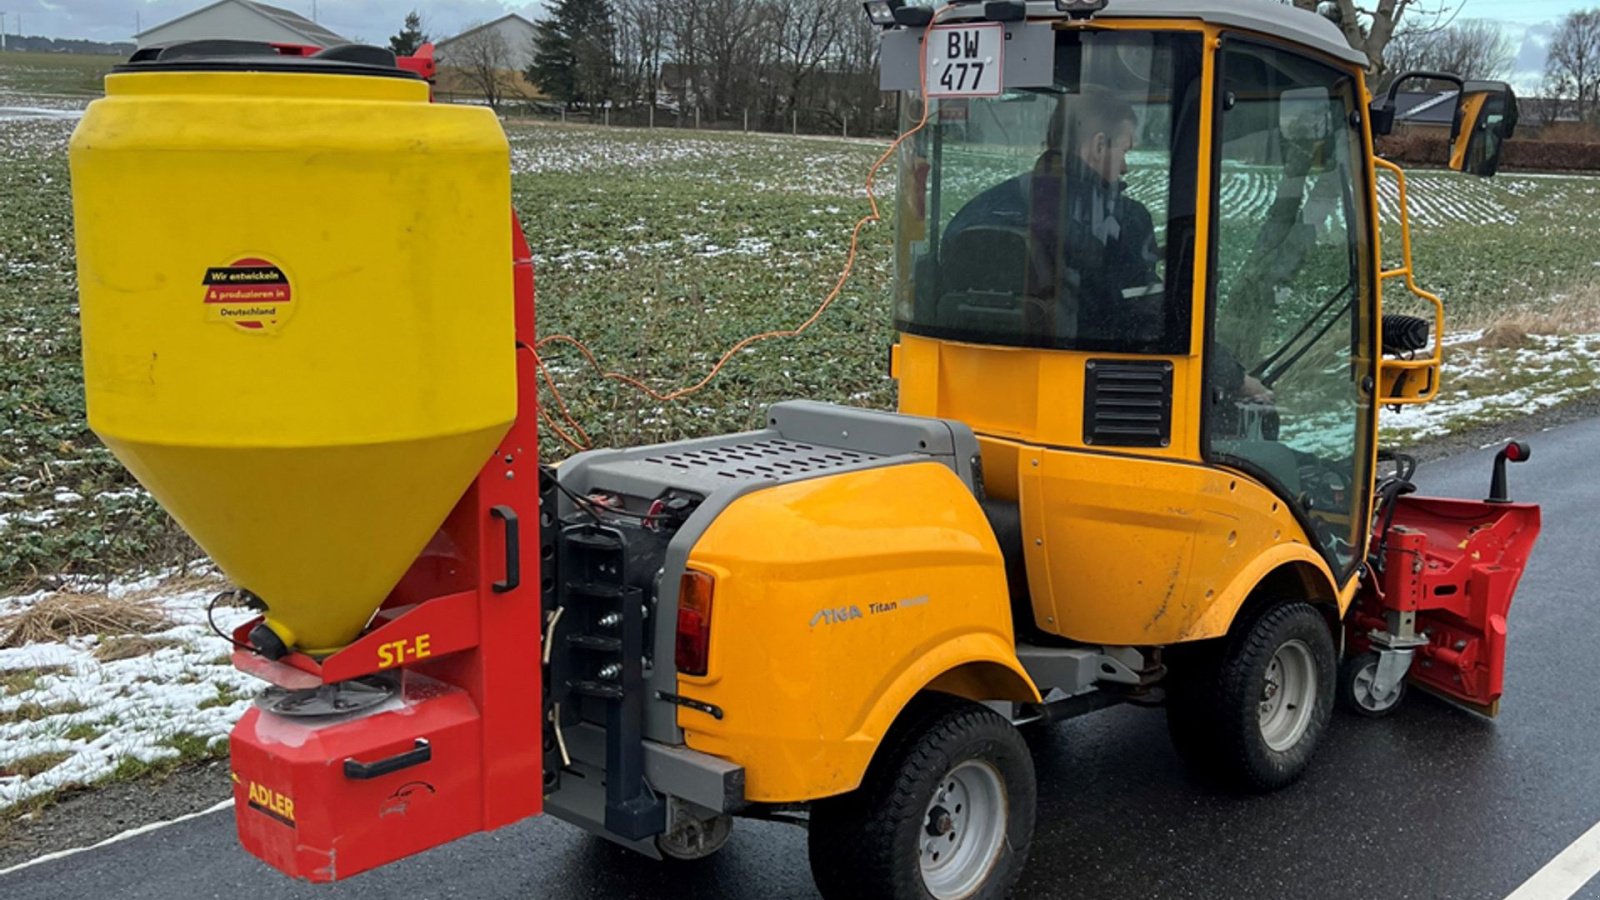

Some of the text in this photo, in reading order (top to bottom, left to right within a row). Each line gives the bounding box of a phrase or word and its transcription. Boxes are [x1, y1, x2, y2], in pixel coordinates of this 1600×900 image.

[947, 30, 979, 59] BW
[940, 62, 984, 91] 477
[211, 271, 279, 280] Wir entwickeln
[210, 290, 285, 300] & produzieren in
[220, 306, 276, 316] Deutschland
[868, 601, 897, 614] Titan
[377, 633, 431, 668] ST-E
[248, 781, 295, 821] ADLER
